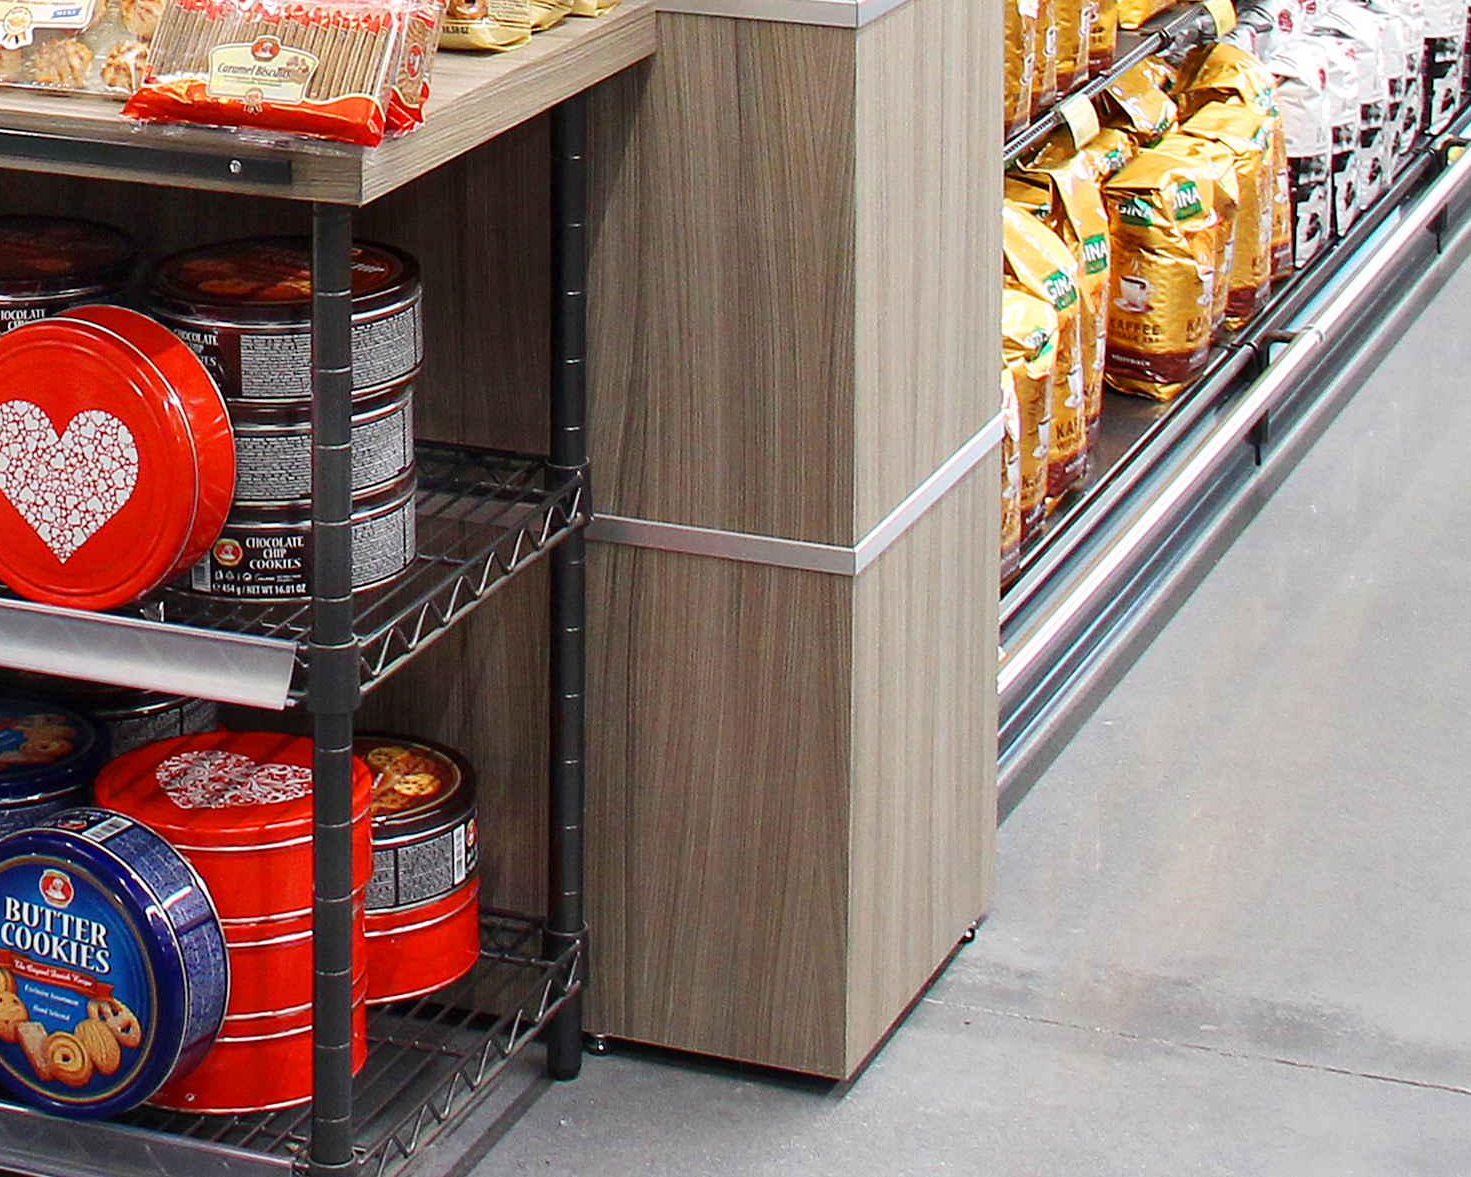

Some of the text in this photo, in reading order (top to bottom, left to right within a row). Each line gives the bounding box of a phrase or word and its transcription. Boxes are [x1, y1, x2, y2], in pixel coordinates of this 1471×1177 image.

[217, 62, 255, 75] Caramel
[245, 536, 305, 549] CHOCOLATE
[262, 548, 288, 560] CHIP
[249, 558, 302, 570] COOKIES
[4, 896, 108, 949] BUTTER
[0, 922, 111, 974] COOKIES
